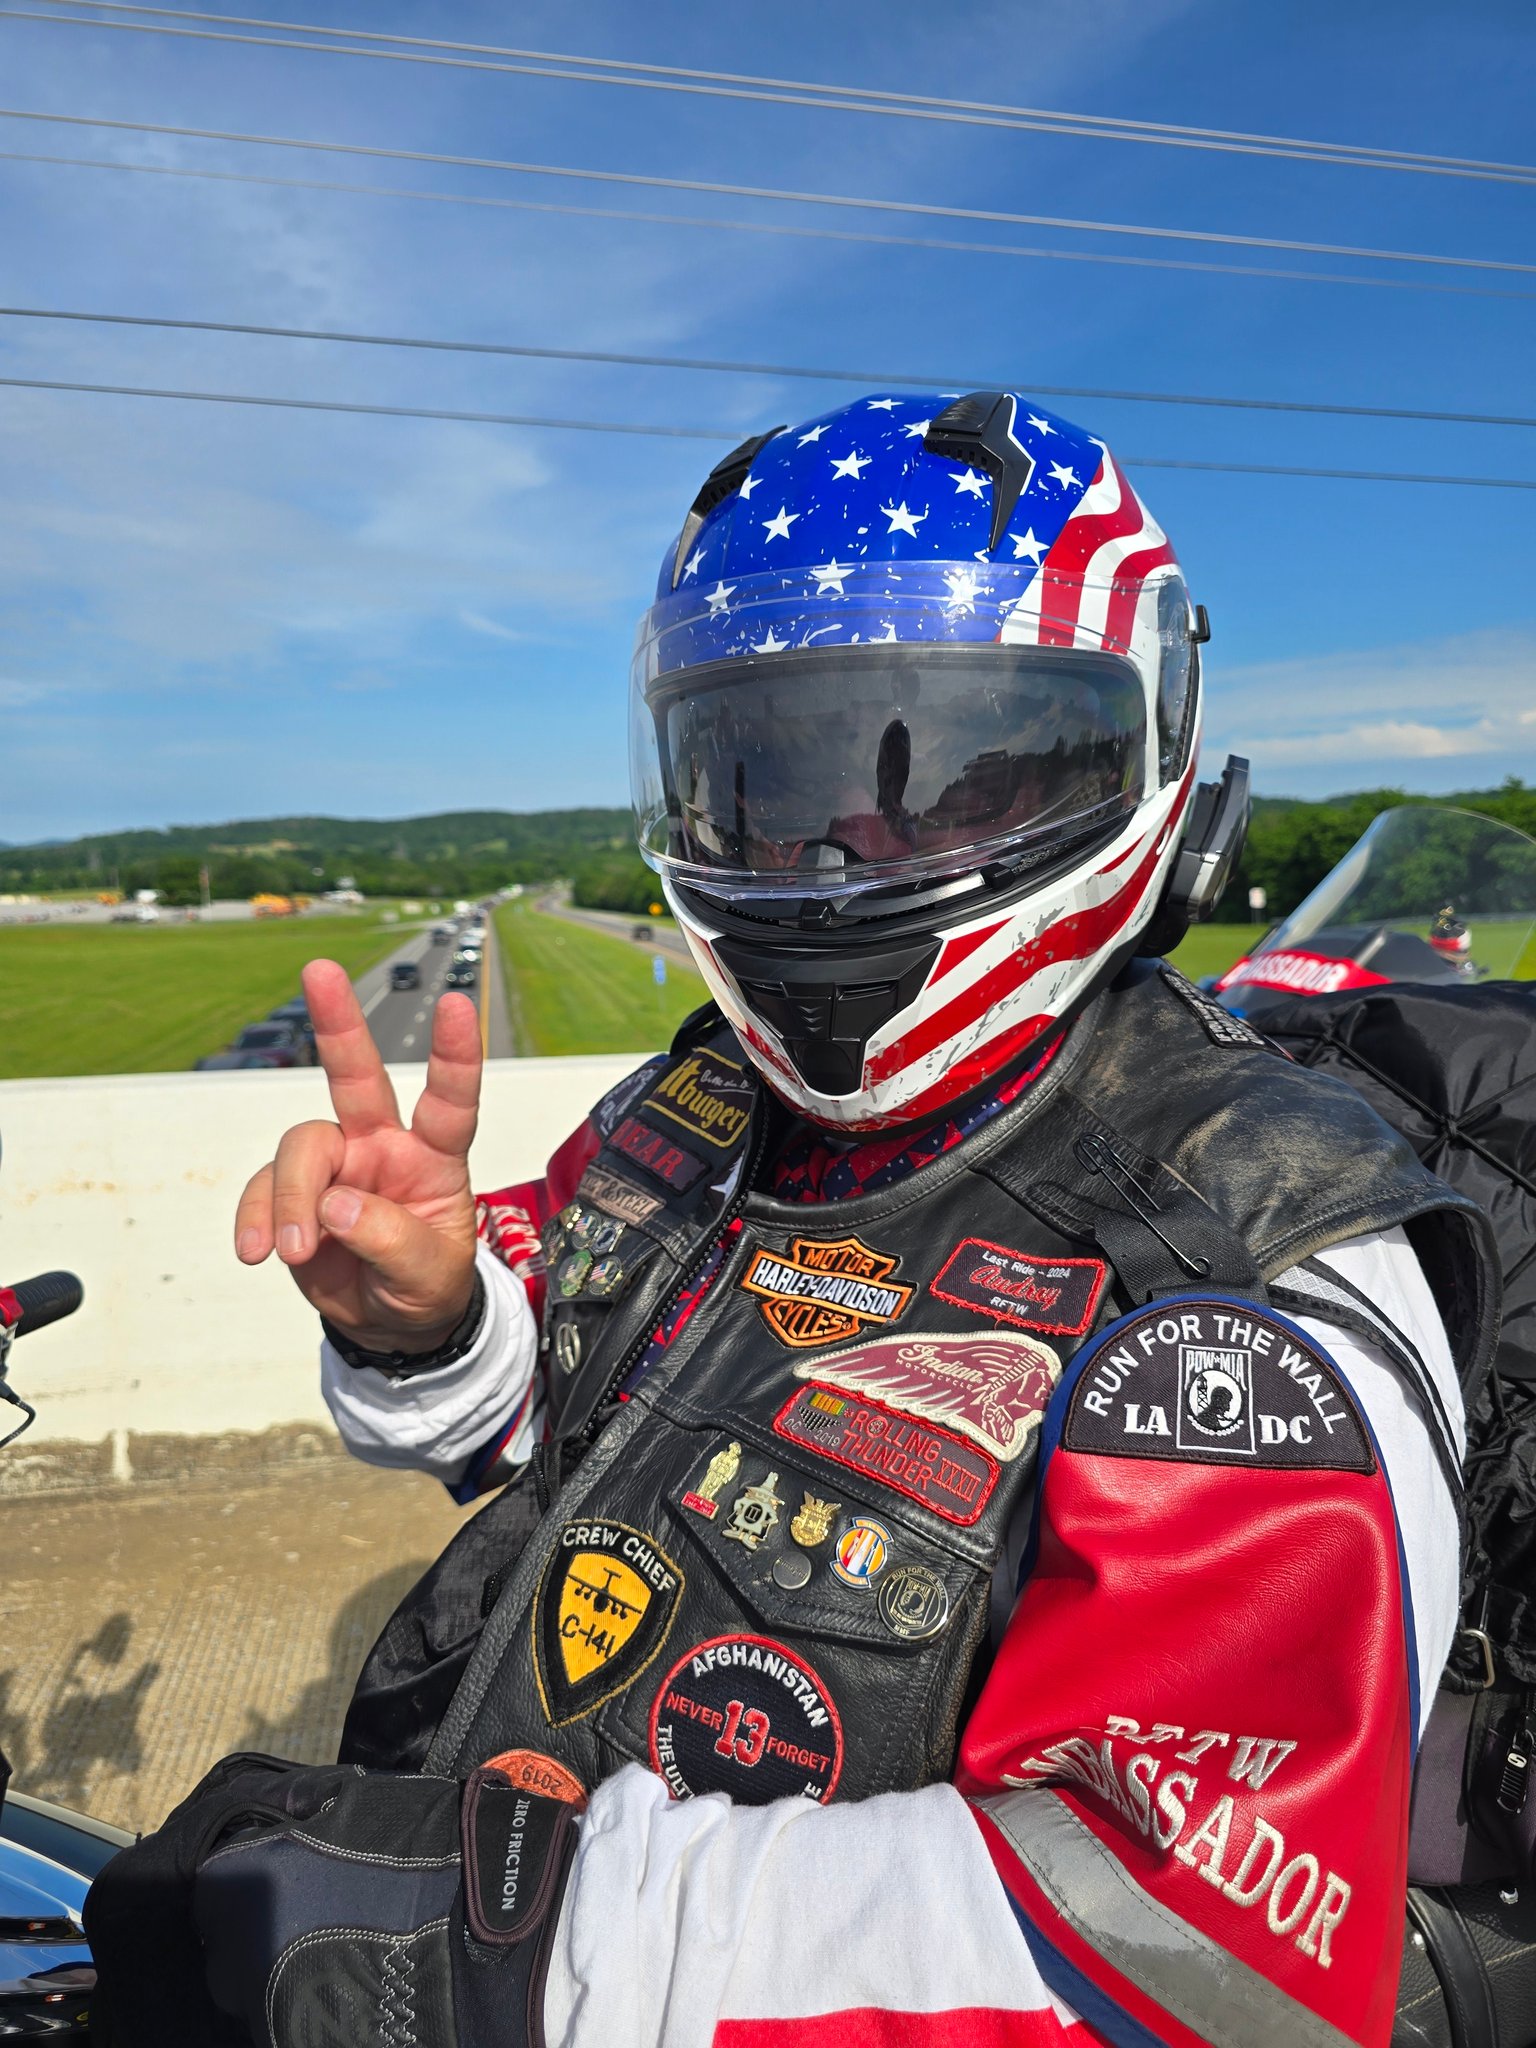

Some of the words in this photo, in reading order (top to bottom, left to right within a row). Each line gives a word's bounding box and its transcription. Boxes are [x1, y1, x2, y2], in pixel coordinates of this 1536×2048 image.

[803, 1247, 875, 1277] MOTOR
[982, 1251, 1009, 1269] Last
[1010, 1262, 1036, 1276] Ride
[751, 1258, 901, 1317] HARLEY-DAVIDSON
[990, 1296, 1030, 1316] RFTW
[773, 1302, 847, 1339] CYCLES
[895, 1358, 973, 1391] MOTORCYCLE
[898, 1343, 984, 1384] Indian
[1084, 1345, 1140, 1417] RUN
[1137, 1314, 1204, 1356] FOR
[1213, 1314, 1275, 1357] THE
[1278, 1344, 1347, 1435] WALL
[814, 1429, 841, 1447] 2019
[851, 1410, 942, 1463] ROLLING
[1123, 1403, 1173, 1437] LA
[1257, 1414, 1313, 1445] DC
[840, 1429, 934, 1491] THUNDER
[931, 1457, 982, 1503] XXXII
[562, 1526, 622, 1548] CREW
[622, 1537, 677, 1592] CHIEF
[560, 1613, 617, 1659] C-141
[691, 1644, 829, 1728] AFGHANISTAN
[665, 1691, 724, 1732] NEVER
[657, 1724, 676, 1764] THE
[714, 1699, 771, 1768] 13
[767, 1735, 831, 1774] FORGET
[522, 1763, 562, 1796] 2019
[511, 1797, 532, 1829] ZERO
[500, 1832, 524, 1911] FRICTION
